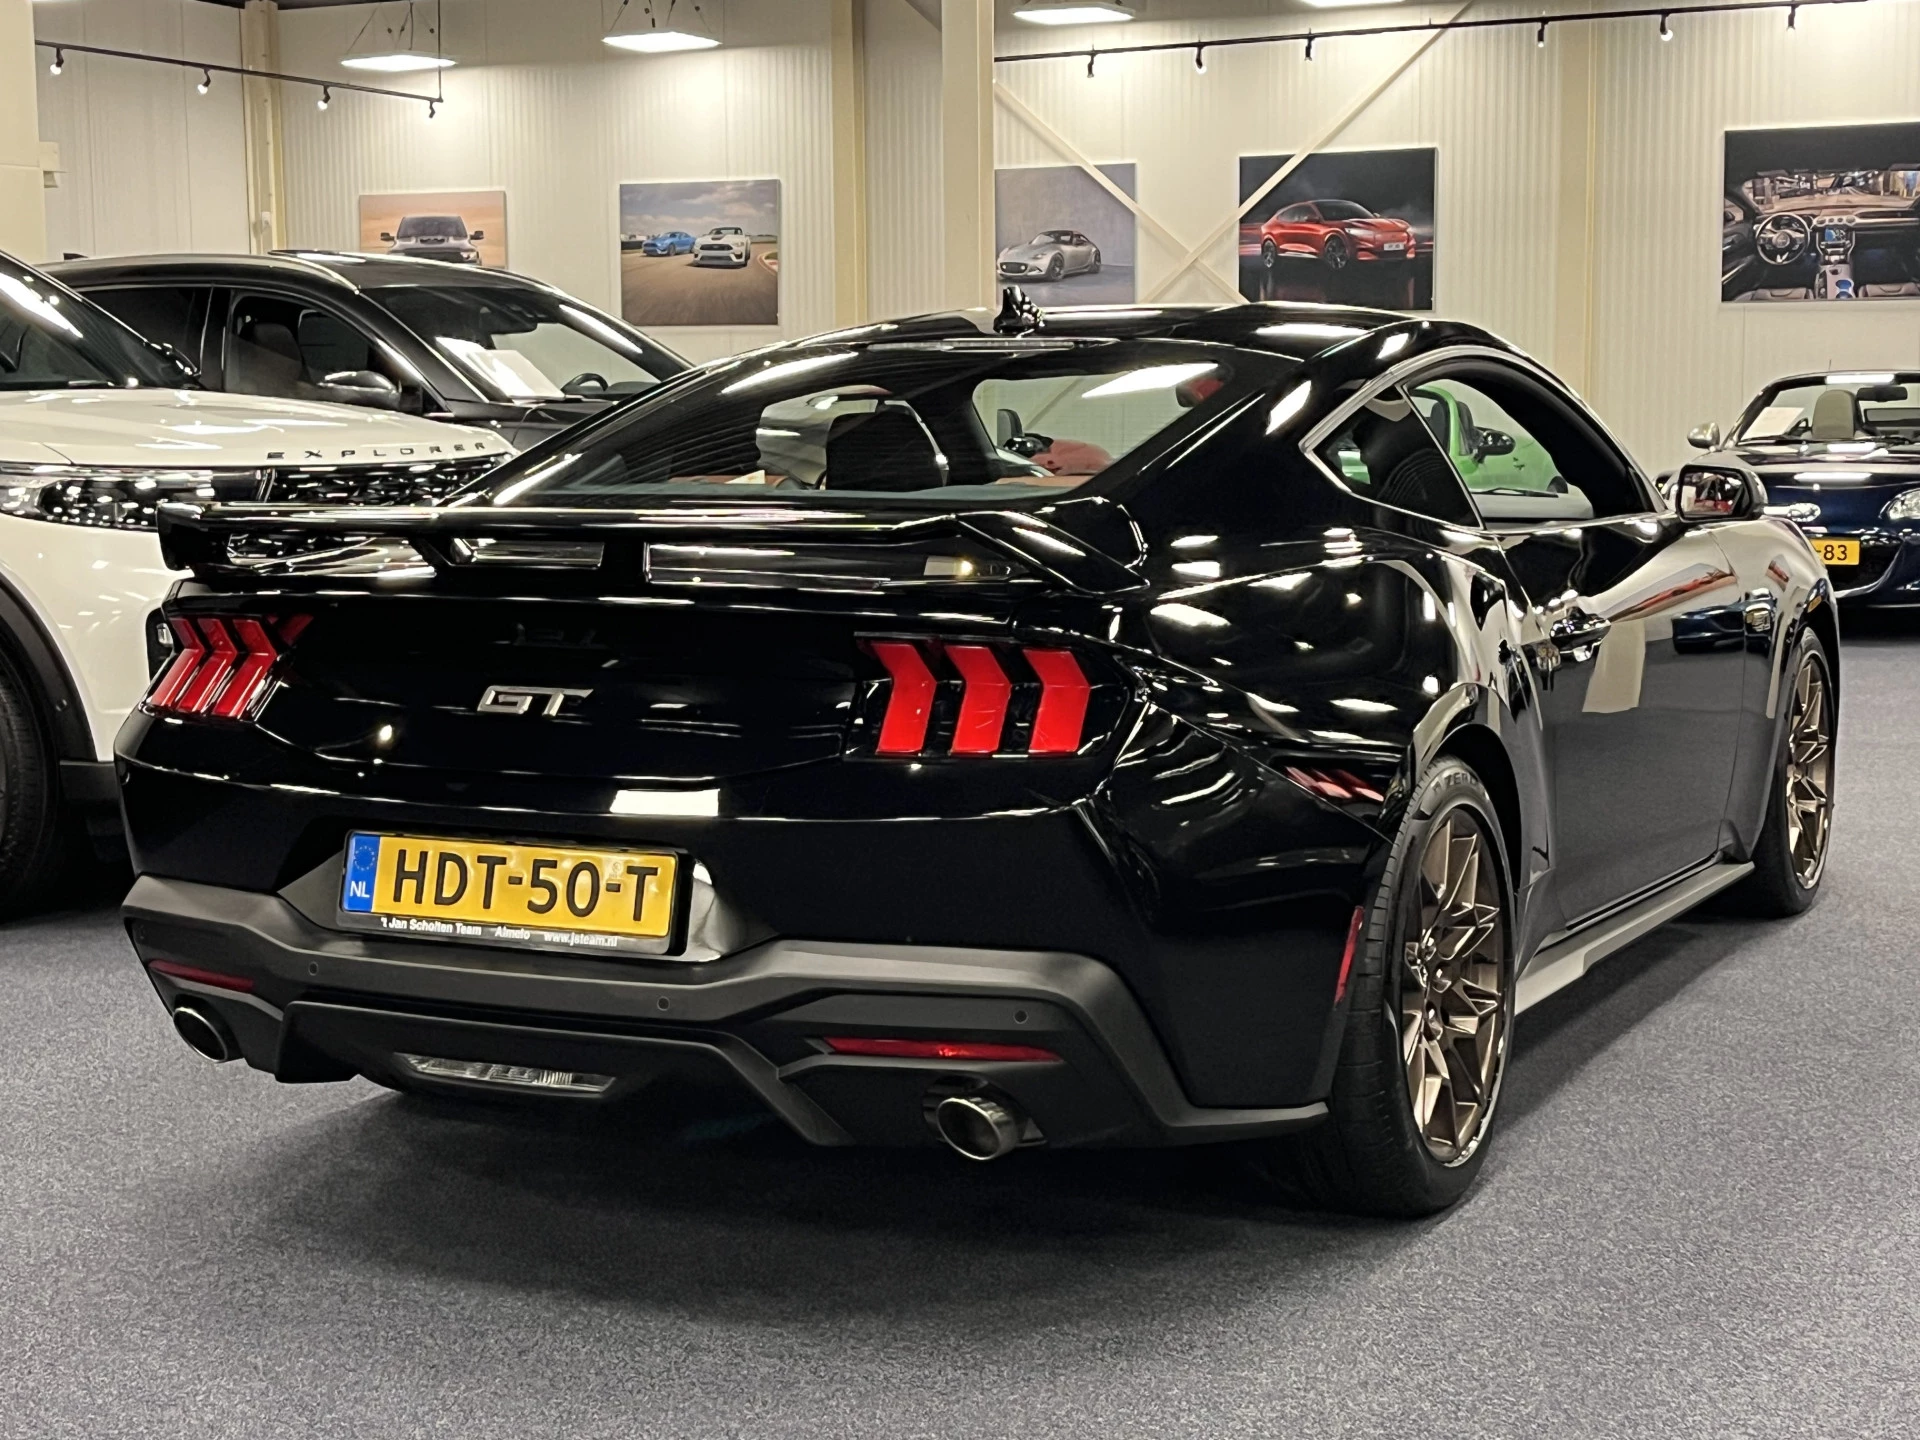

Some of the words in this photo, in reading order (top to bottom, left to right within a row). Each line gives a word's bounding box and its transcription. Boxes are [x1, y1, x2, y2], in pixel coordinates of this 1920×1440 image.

[266, 442, 486, 460] EXPLORER
[477, 685, 594, 717] GT
[349, 880, 370, 899] NL
[393, 848, 658, 922] HDT-50-T
[388, 917, 407, 929] Jan
[409, 918, 453, 933] Scholten
[455, 922, 482, 935] Team
[495, 926, 531, 940] Almelo
[544, 931, 618, 947] www.jsteam.nl
